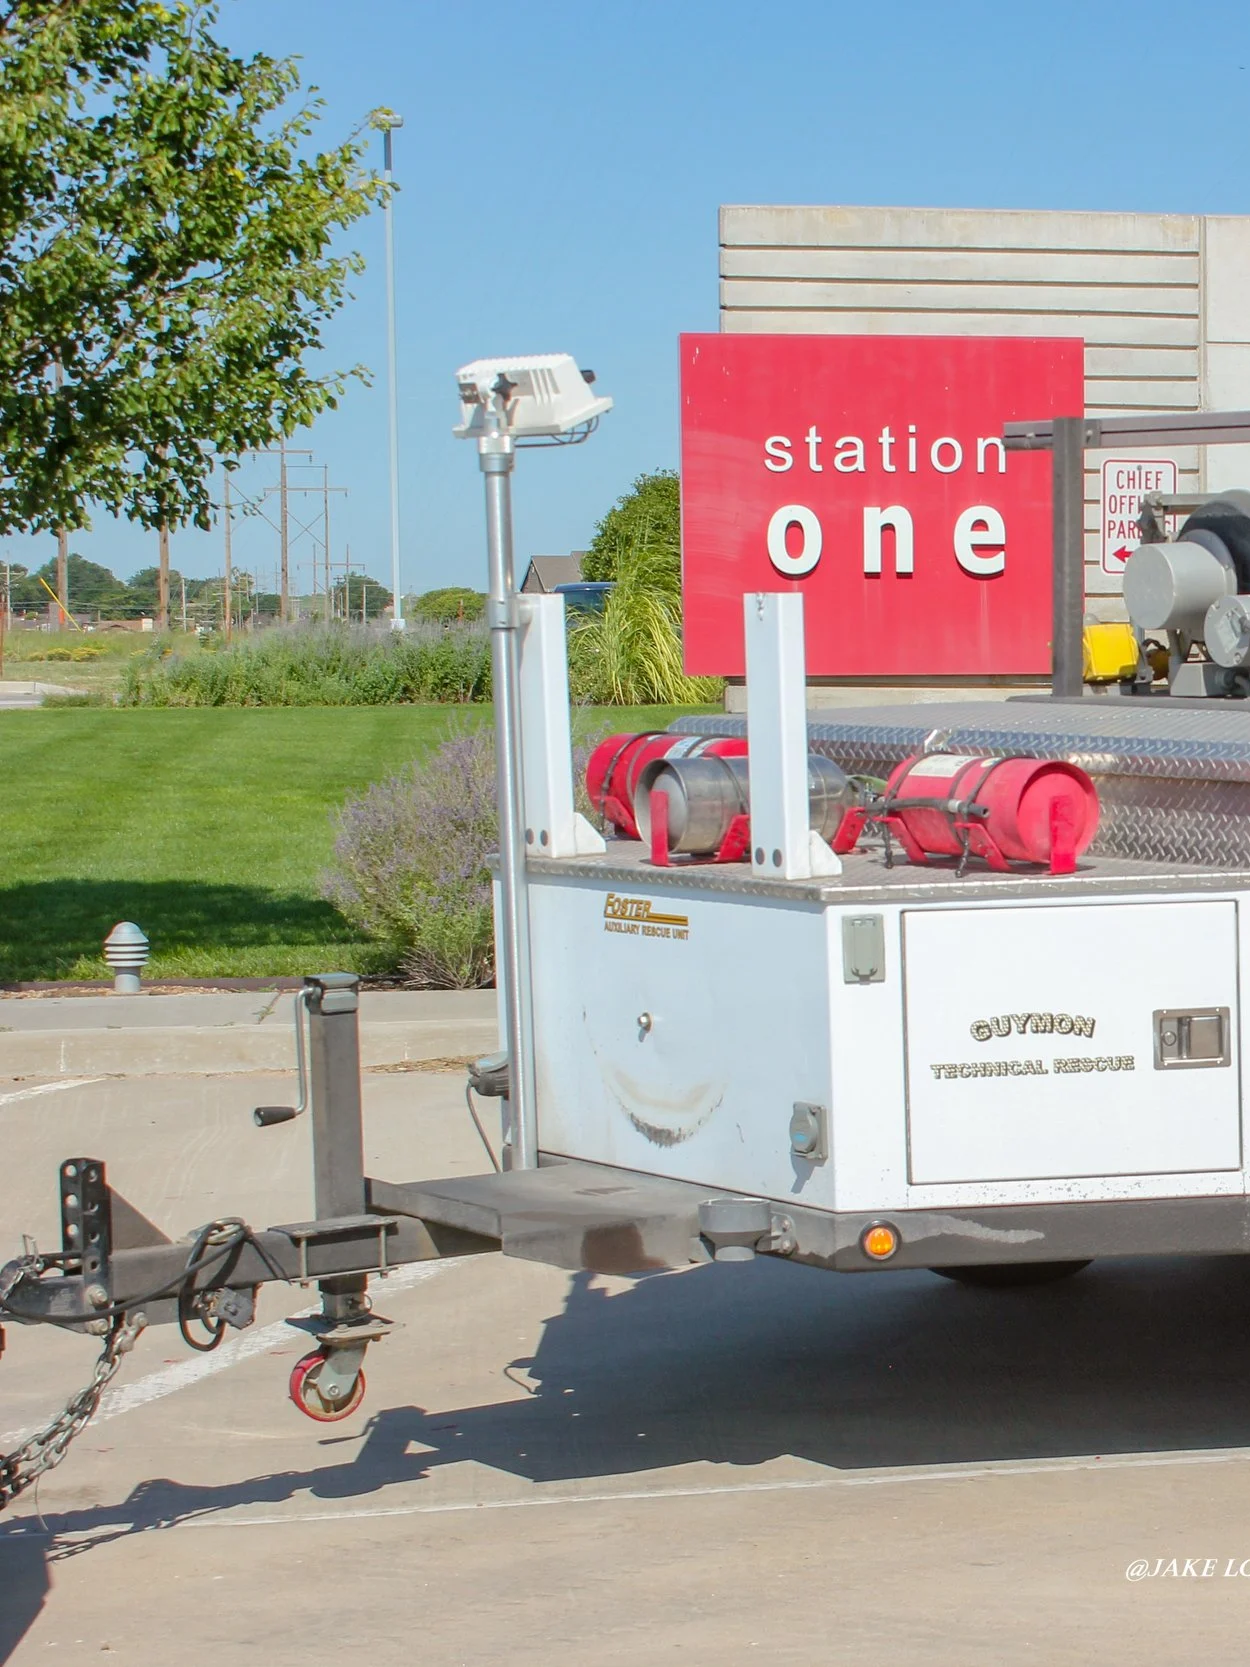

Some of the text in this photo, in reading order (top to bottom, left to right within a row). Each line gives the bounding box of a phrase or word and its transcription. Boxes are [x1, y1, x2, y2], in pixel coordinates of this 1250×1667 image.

[764, 424, 1006, 473] station
[1116, 470, 1163, 490] CHIEF
[1108, 494, 1148, 514] OFFI
[767, 504, 1006, 577] one
[604, 893, 652, 918] FOSTER
[604, 921, 689, 940] AUXILIARY RESCUE UNIT
[970, 1012, 1096, 1042] GUYMON
[930, 1055, 1135, 1080] TECHNICAL RESCUE
